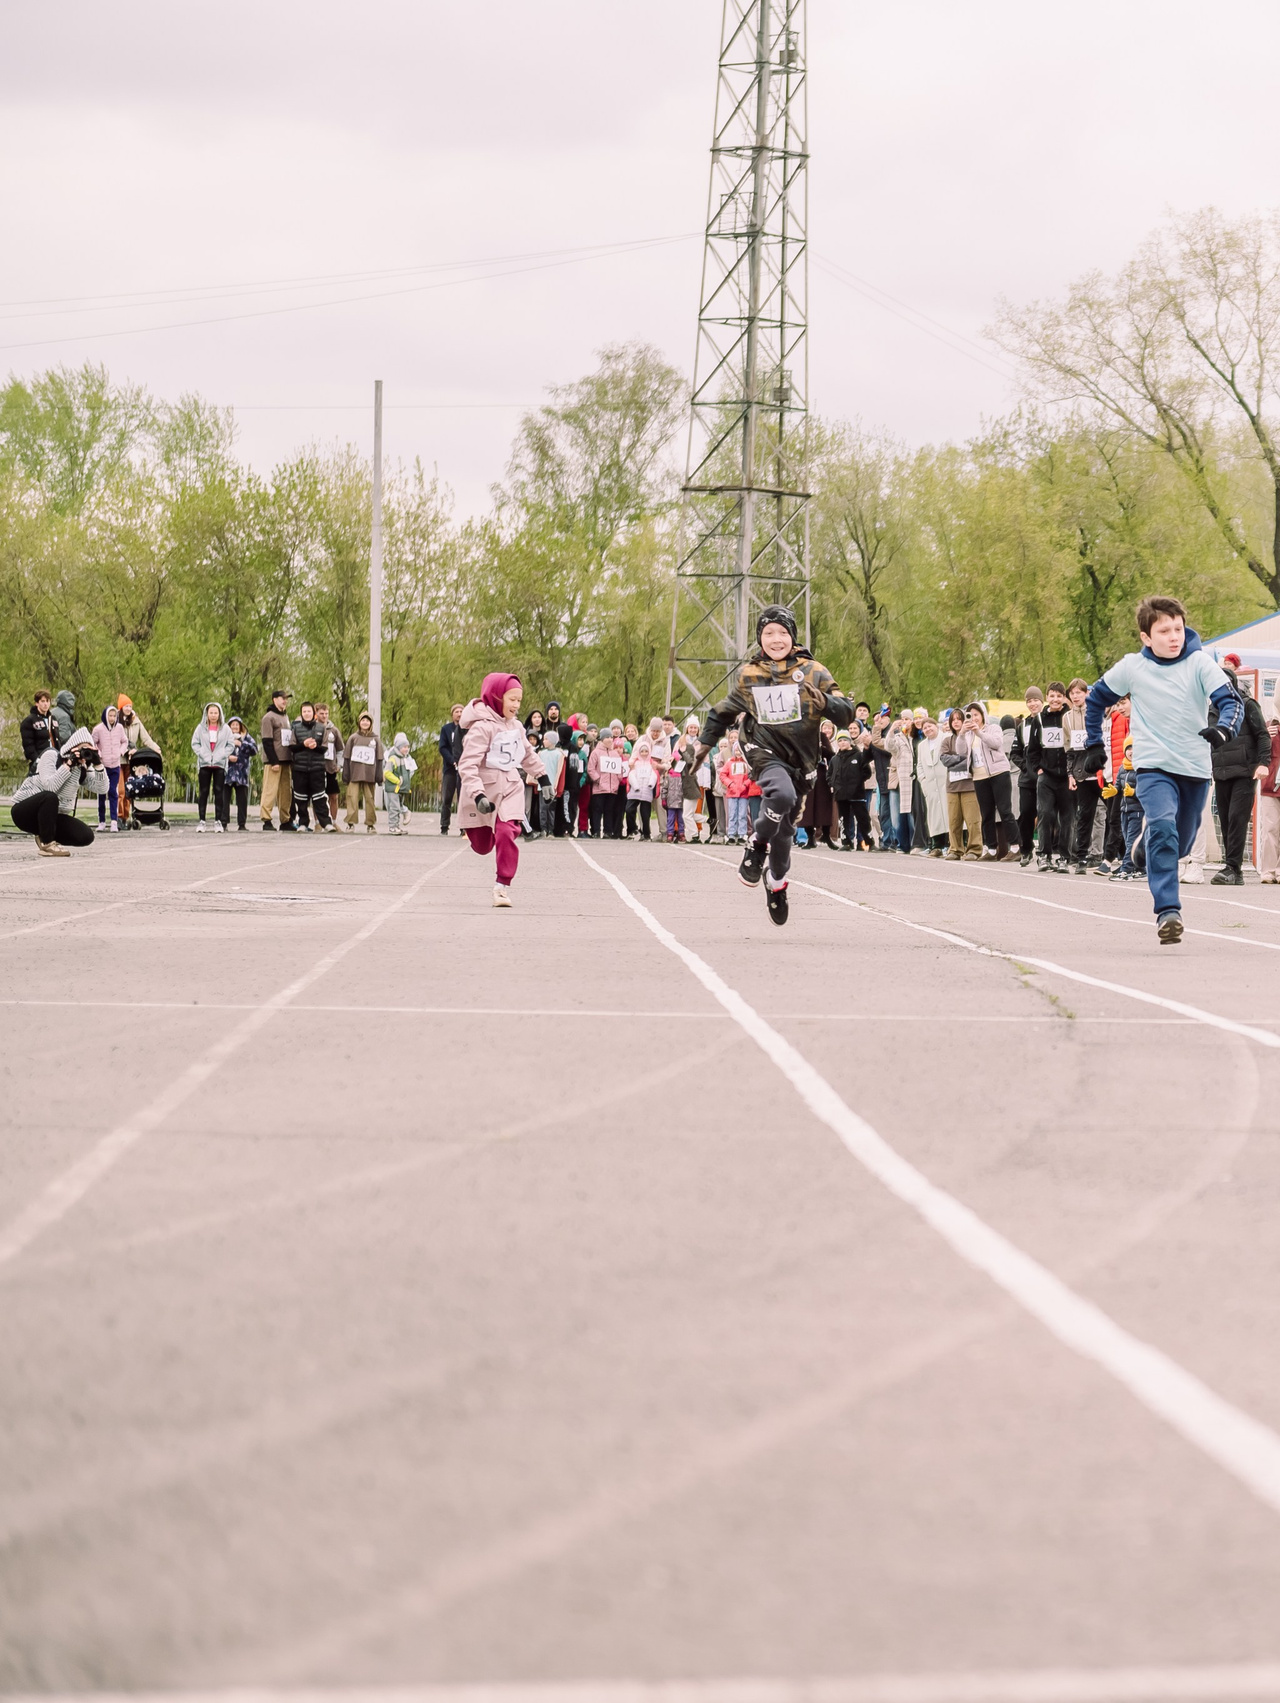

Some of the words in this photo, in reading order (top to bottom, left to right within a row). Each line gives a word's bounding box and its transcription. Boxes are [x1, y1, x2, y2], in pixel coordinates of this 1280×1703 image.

[766, 691, 787, 713] 11
[1047, 732, 1061, 743] 24
[356, 750, 370, 762] 45
[605, 761, 616, 770] 70
